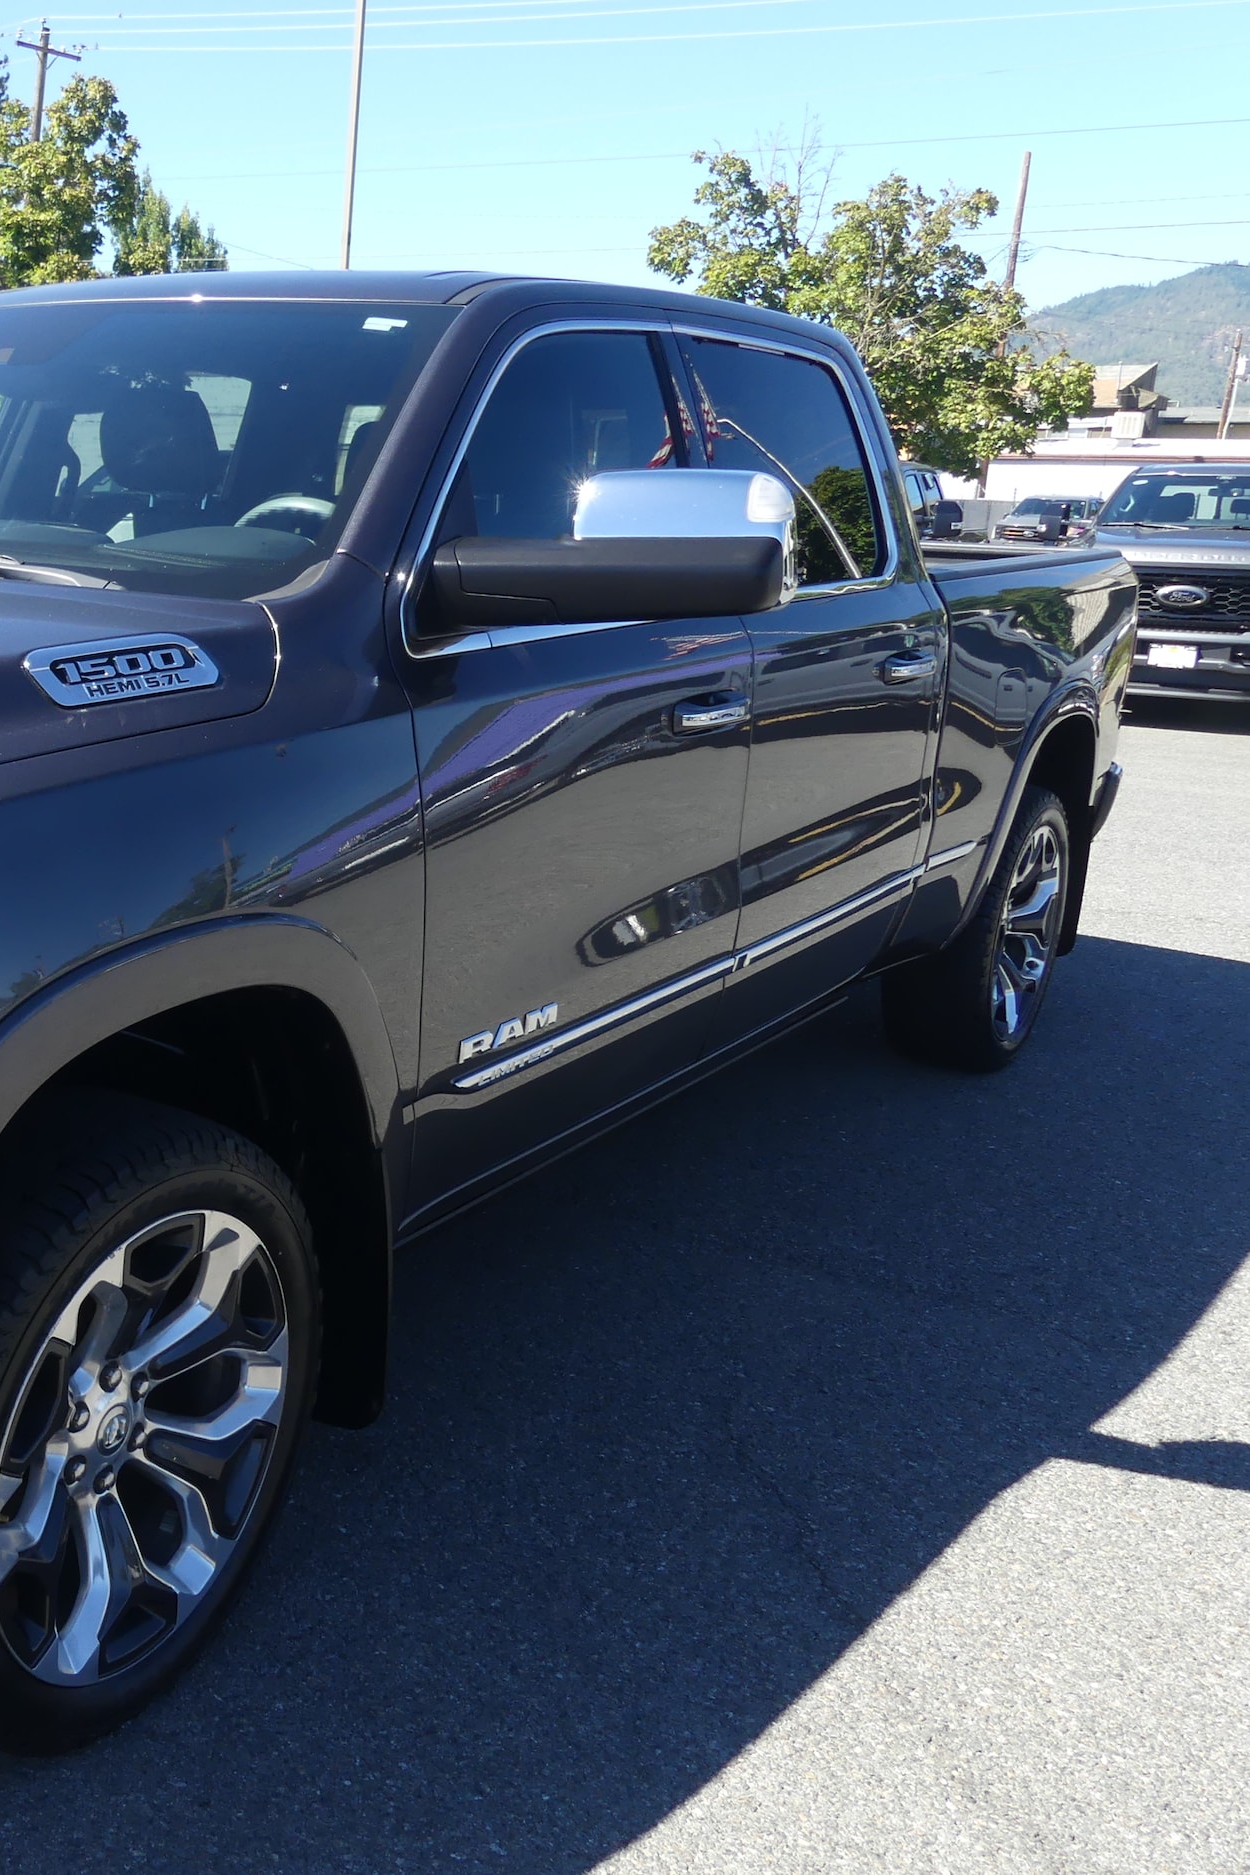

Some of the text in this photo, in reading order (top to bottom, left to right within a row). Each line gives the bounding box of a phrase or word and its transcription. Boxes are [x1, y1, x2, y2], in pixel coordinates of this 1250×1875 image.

[57, 648, 185, 683] 1500
[85, 674, 190, 698] HEMI 5.7L
[458, 1002, 558, 1064] RAM
[478, 1045, 554, 1086] LIMITED
